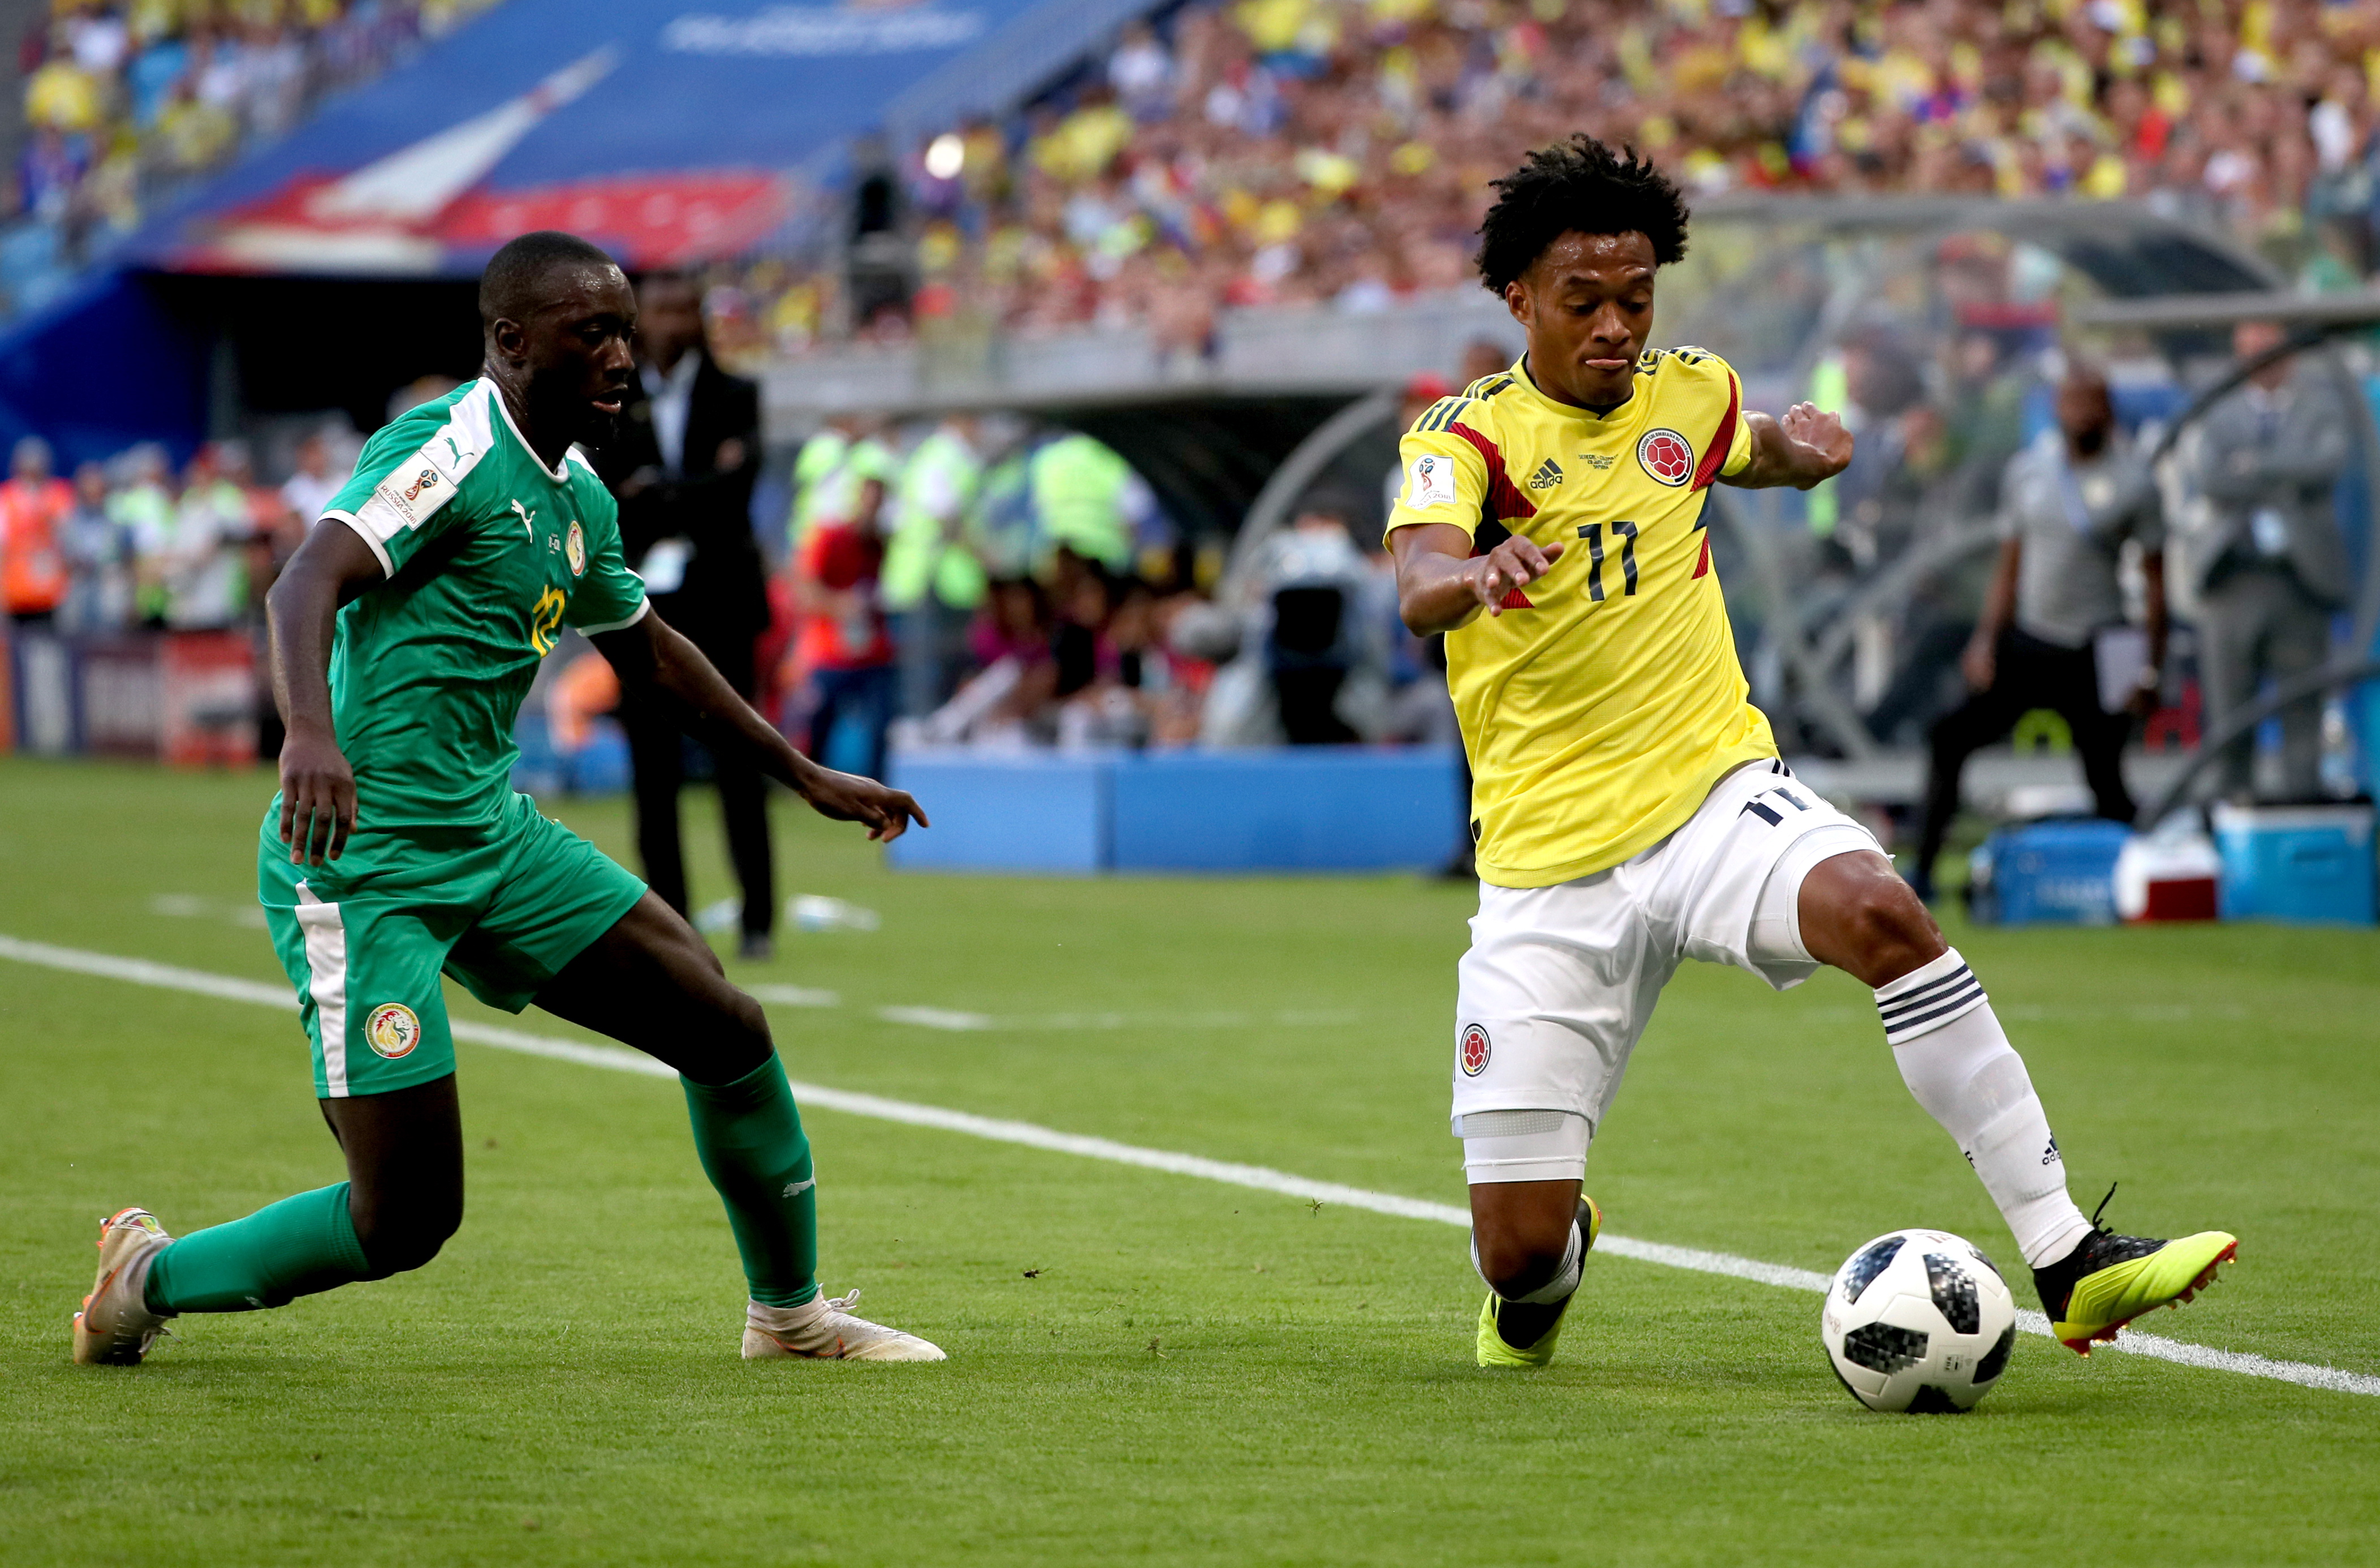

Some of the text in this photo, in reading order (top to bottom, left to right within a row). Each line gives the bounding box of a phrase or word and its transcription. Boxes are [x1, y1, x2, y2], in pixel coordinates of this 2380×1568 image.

[1530, 476, 1563, 489] adida
[380, 485, 417, 524] RUSSIA 2018
[1577, 521, 1638, 602] 11
